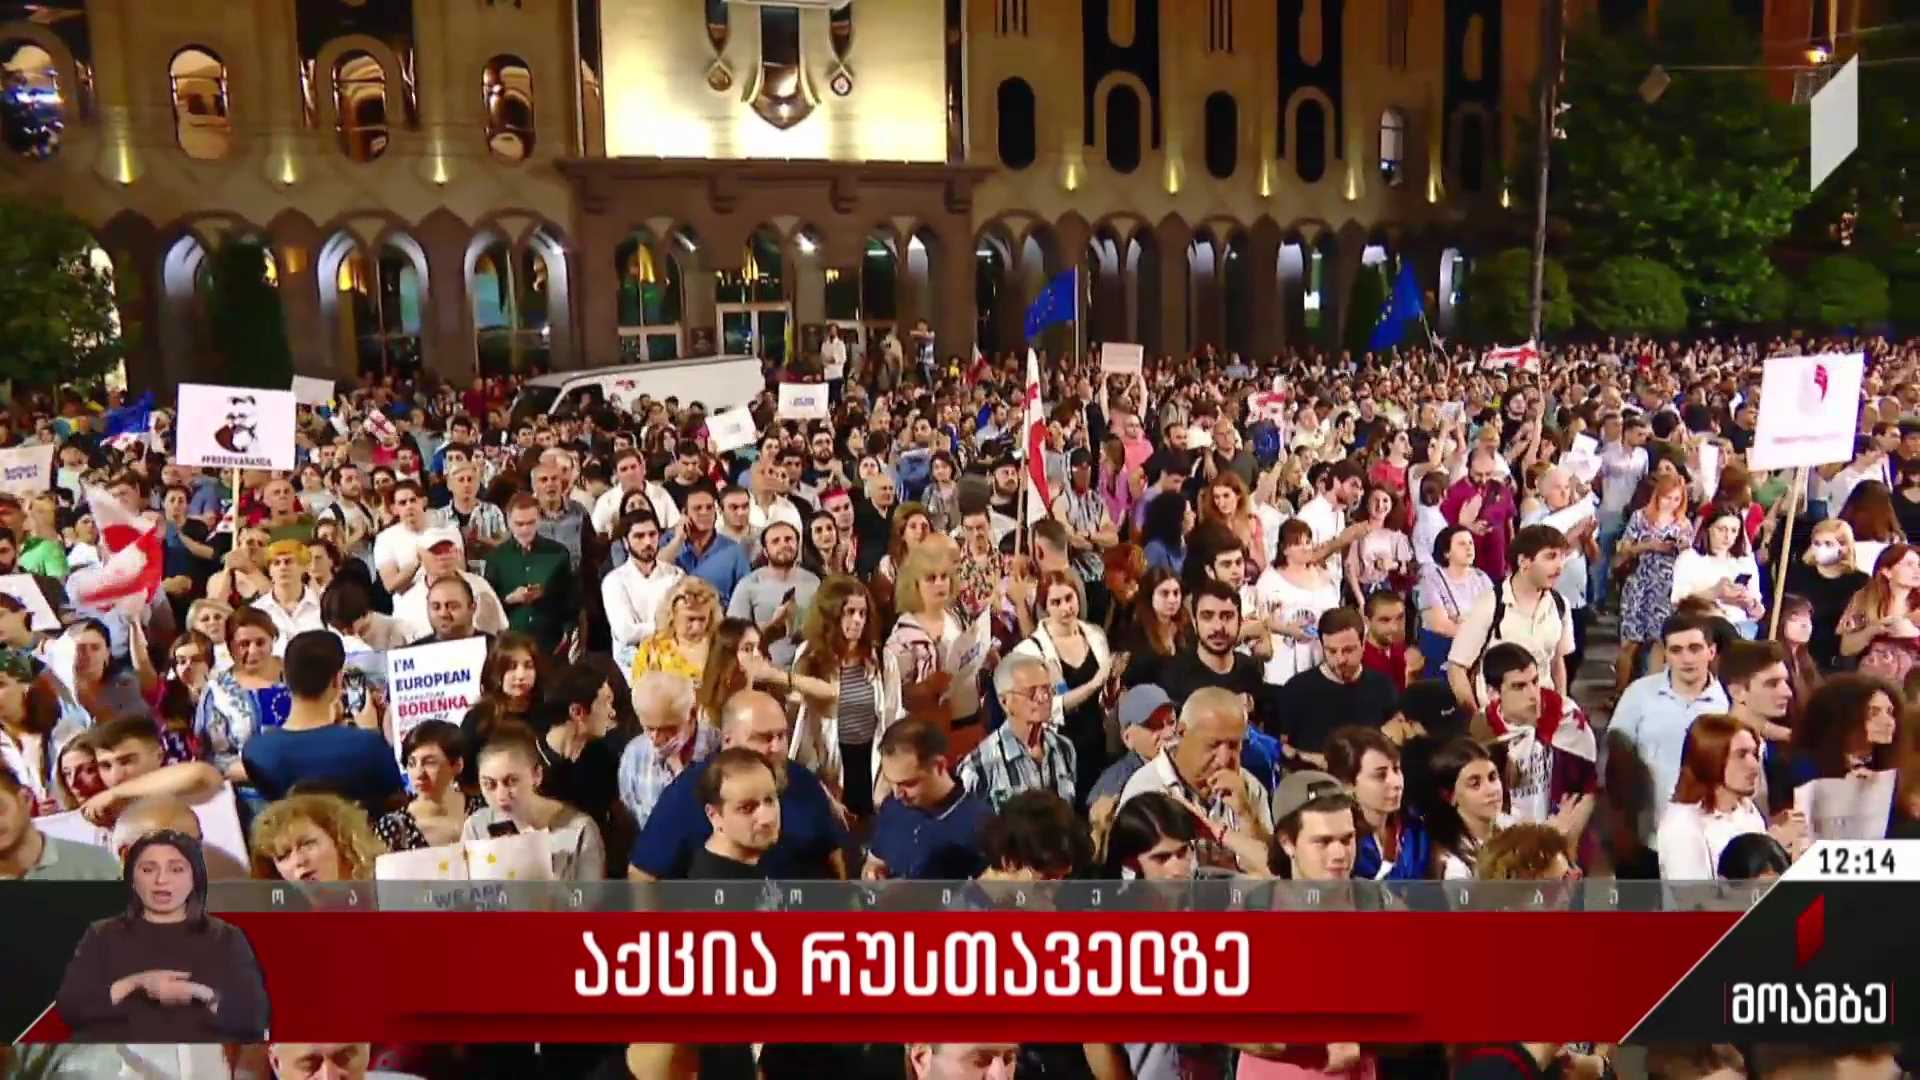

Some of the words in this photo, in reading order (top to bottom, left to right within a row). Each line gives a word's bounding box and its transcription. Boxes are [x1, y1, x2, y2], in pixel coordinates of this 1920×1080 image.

[394, 658, 415, 672] I'M
[395, 668, 471, 692] EUROPEAN
[398, 695, 469, 717] BORENKA
